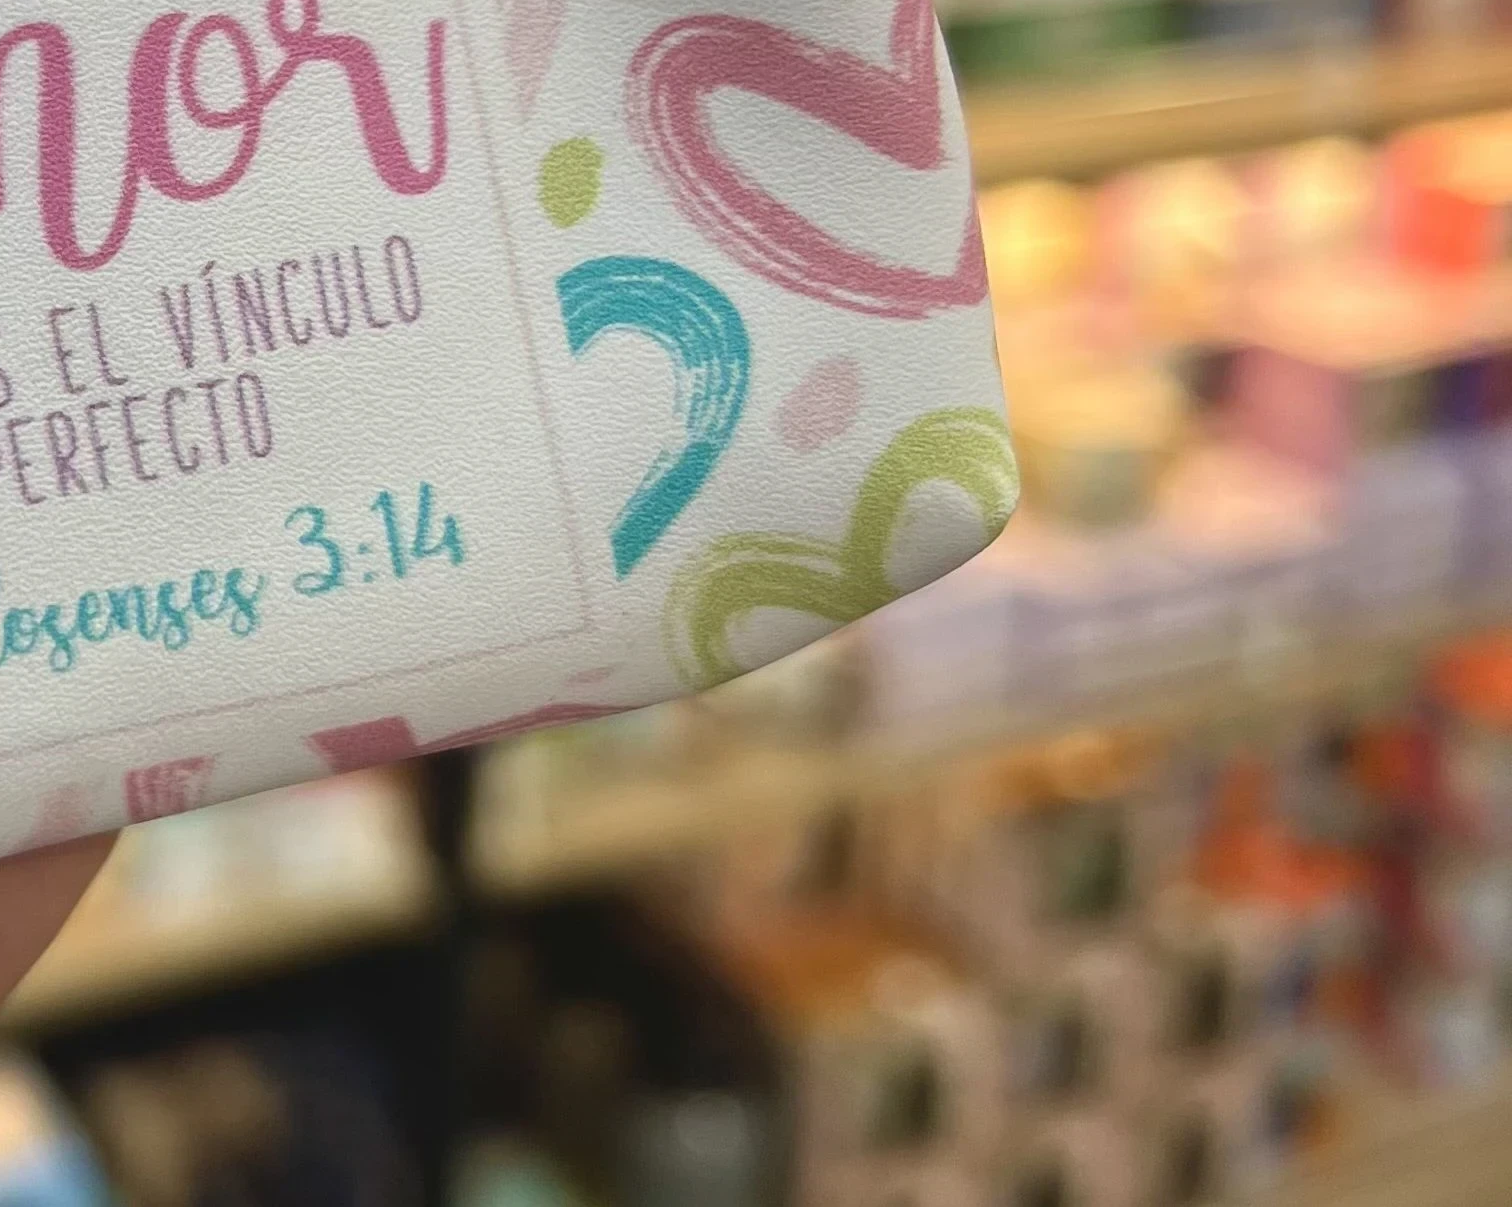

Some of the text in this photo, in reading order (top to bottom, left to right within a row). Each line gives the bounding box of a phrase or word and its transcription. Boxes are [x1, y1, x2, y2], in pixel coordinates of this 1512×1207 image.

[48, 302, 128, 395] EL
[159, 233, 424, 372] VÍNCULO
[284, 480, 466, 596] 3:14
